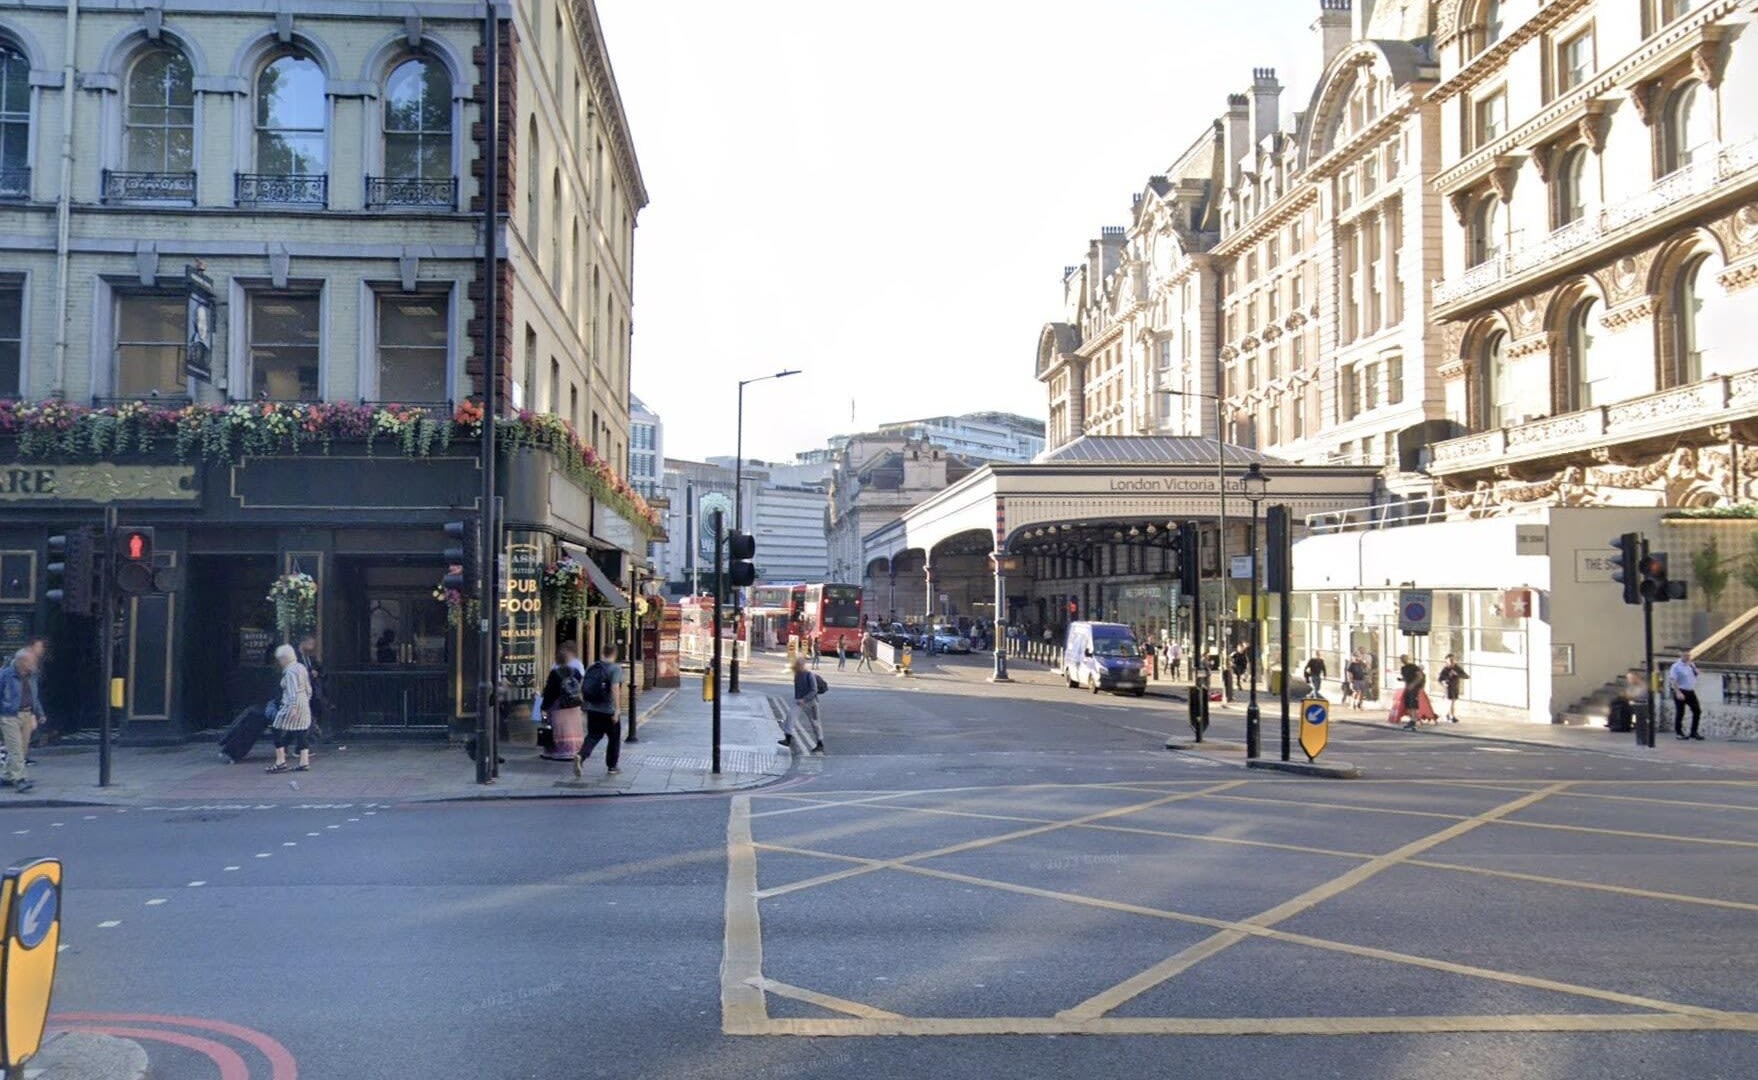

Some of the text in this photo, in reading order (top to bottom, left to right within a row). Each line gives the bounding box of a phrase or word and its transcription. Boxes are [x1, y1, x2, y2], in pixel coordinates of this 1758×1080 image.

[1110, 478, 1160, 490] London
[1163, 478, 1215, 490] Victoria
[1585, 558, 1602, 570] THE
[507, 580, 537, 593] PUB
[499, 599, 542, 612] FOOD
[501, 662, 536, 675] FISH
